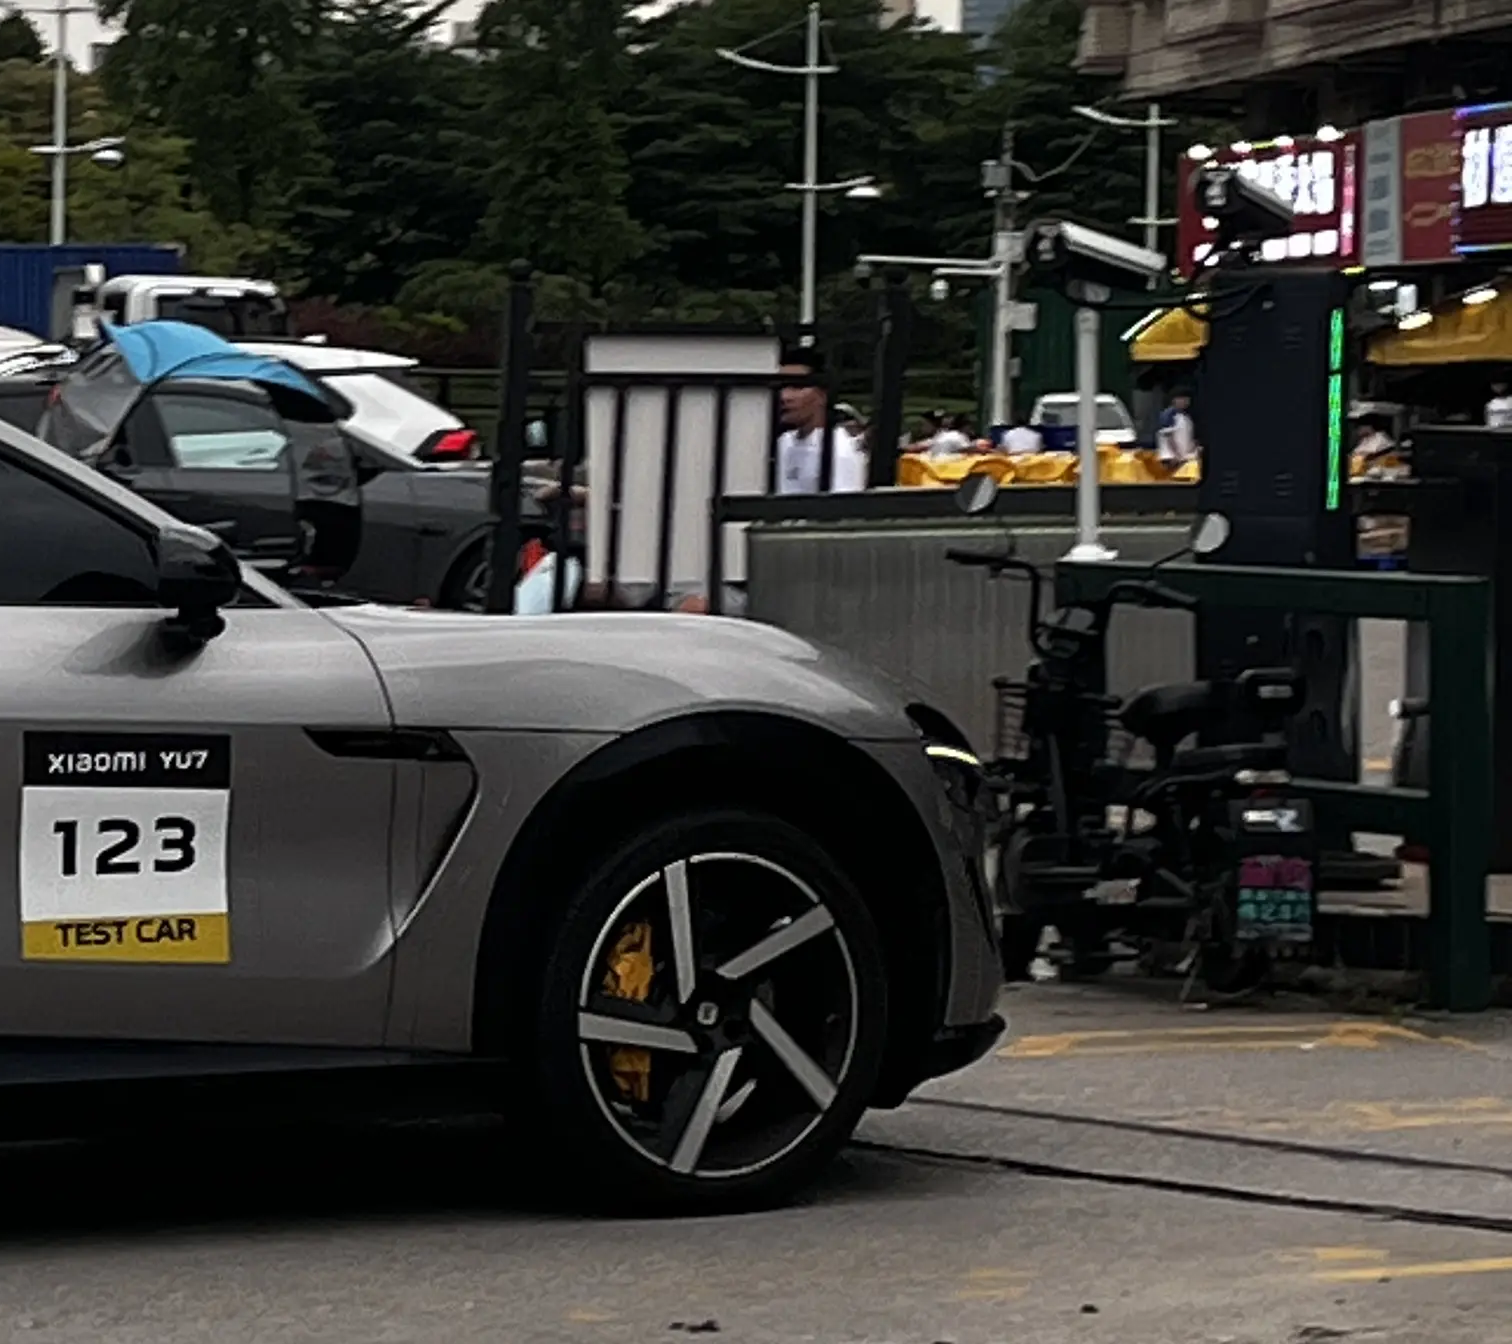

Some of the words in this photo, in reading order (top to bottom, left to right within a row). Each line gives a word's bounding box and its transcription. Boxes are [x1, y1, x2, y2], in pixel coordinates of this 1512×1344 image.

[52, 816, 197, 877] 123
[54, 921, 131, 947] TEST
[135, 918, 197, 944] CAR
